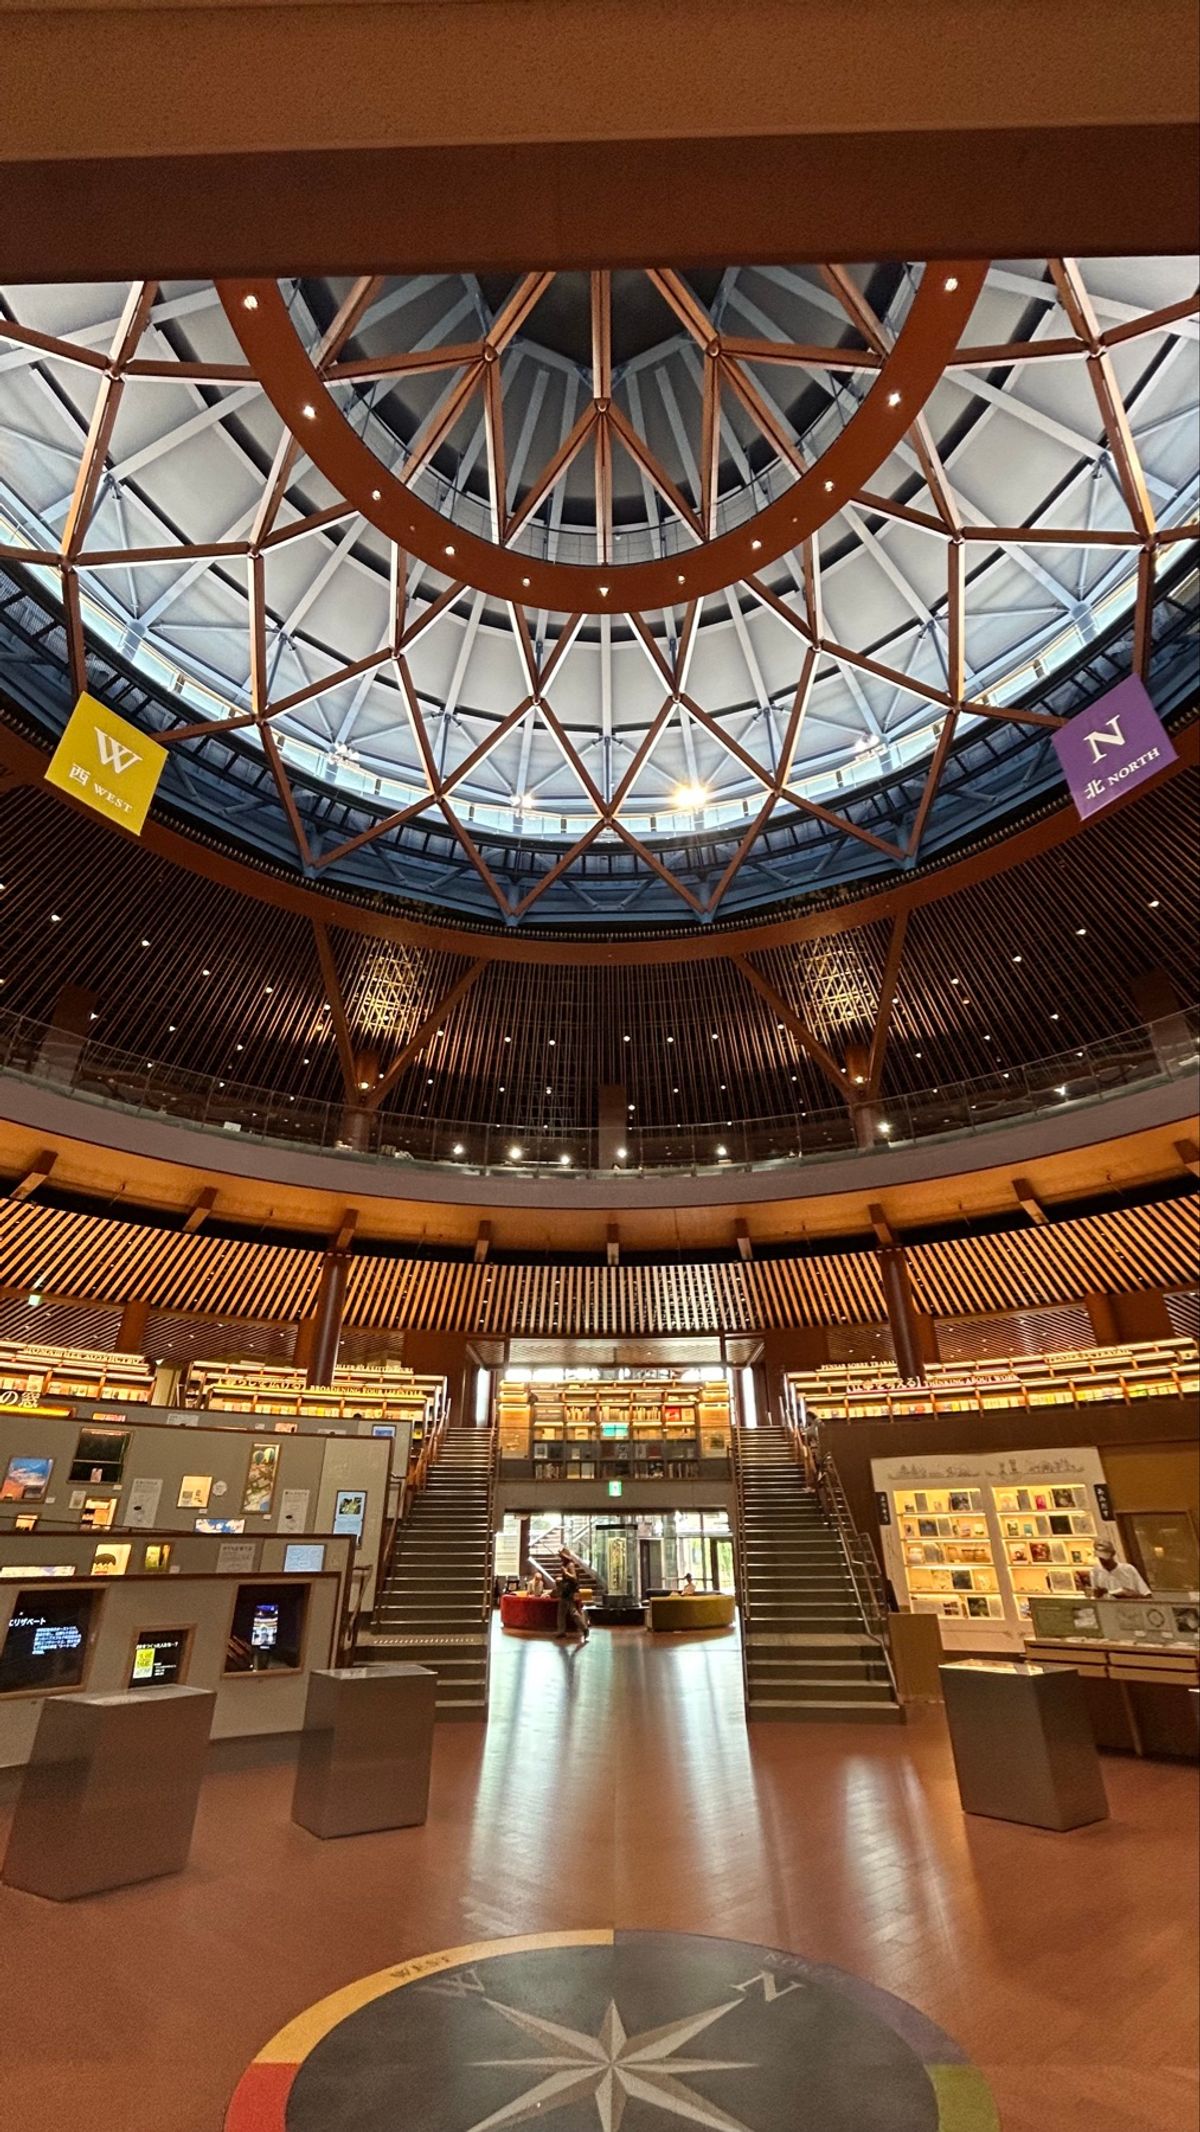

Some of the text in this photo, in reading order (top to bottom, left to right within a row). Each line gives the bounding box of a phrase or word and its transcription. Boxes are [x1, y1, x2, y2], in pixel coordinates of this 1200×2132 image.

[94, 726, 143, 774] W
[1083, 714, 1126, 764] N
[69, 762, 133, 813] 西 WEST
[1084, 747, 1161, 800] 北 NORTH
[390, 1956, 450, 1978] WEST
[412, 1968, 486, 1997] W
[730, 1970, 806, 2002] N
